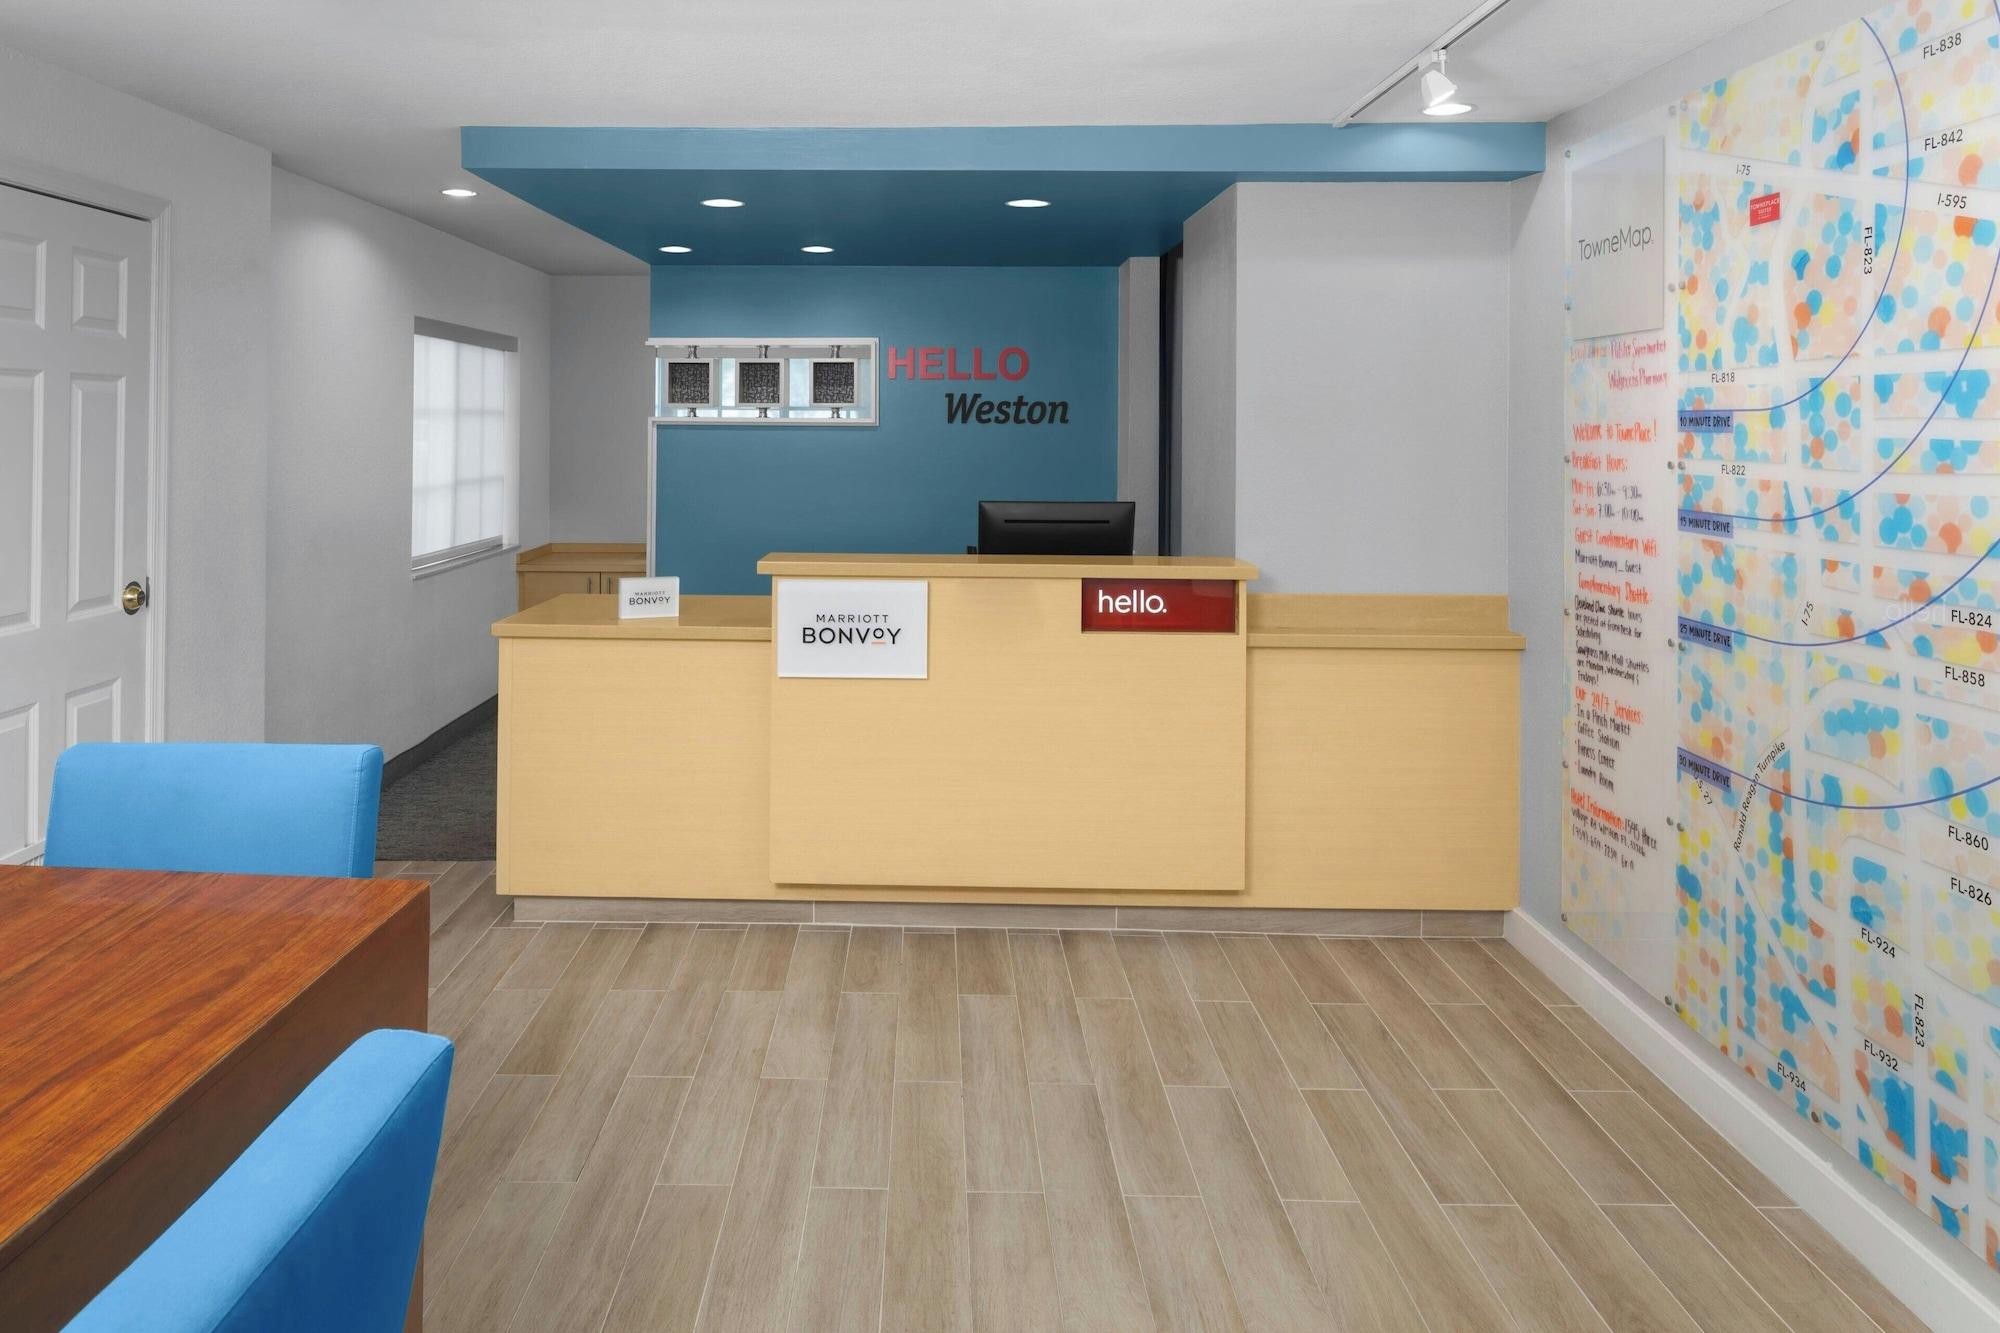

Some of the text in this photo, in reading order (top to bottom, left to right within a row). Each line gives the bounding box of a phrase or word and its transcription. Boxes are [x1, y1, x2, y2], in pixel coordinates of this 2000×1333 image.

[1923, 33, 1962, 58] FL-838
[1924, 129, 1963, 151] FL-842
[1736, 164, 1751, 176] I-75
[1937, 194, 1967, 209] I-595
[1578, 225, 1652, 261] TowneMap
[1864, 227, 1872, 275] FL-823
[887, 346, 1030, 382] HELLO
[1711, 372, 1735, 383] FL-818
[945, 393, 1069, 425] Weston
[1680, 416, 1730, 428] 10 MINUTE DRIVE
[1721, 464, 1746, 476] FL-822
[1680, 516, 1730, 533] 15 MINUTE DRIVE
[1098, 589, 1168, 614] hello.
[1801, 601, 1814, 626] I-75
[816, 614, 889, 624] MARRIOTT
[1951, 610, 1992, 628] FL-824
[1680, 623, 1731, 647] 25 MINUTE DRIVE
[1945, 666, 1985, 687] FL-858
[1679, 755, 1730, 788] 30 MINUTE DRIVE
[1733, 741, 1786, 853] Ronald Reagan Turnpike
[1948, 825, 1989, 851] FL-860
[1950, 877, 1992, 906] FL-826
[1861, 928, 1896, 958] FL-924
[1914, 993, 1925, 1048] FL-823
[1864, 1039, 1899, 1072] FL-932
[1776, 1062, 1806, 1092] FL-934
